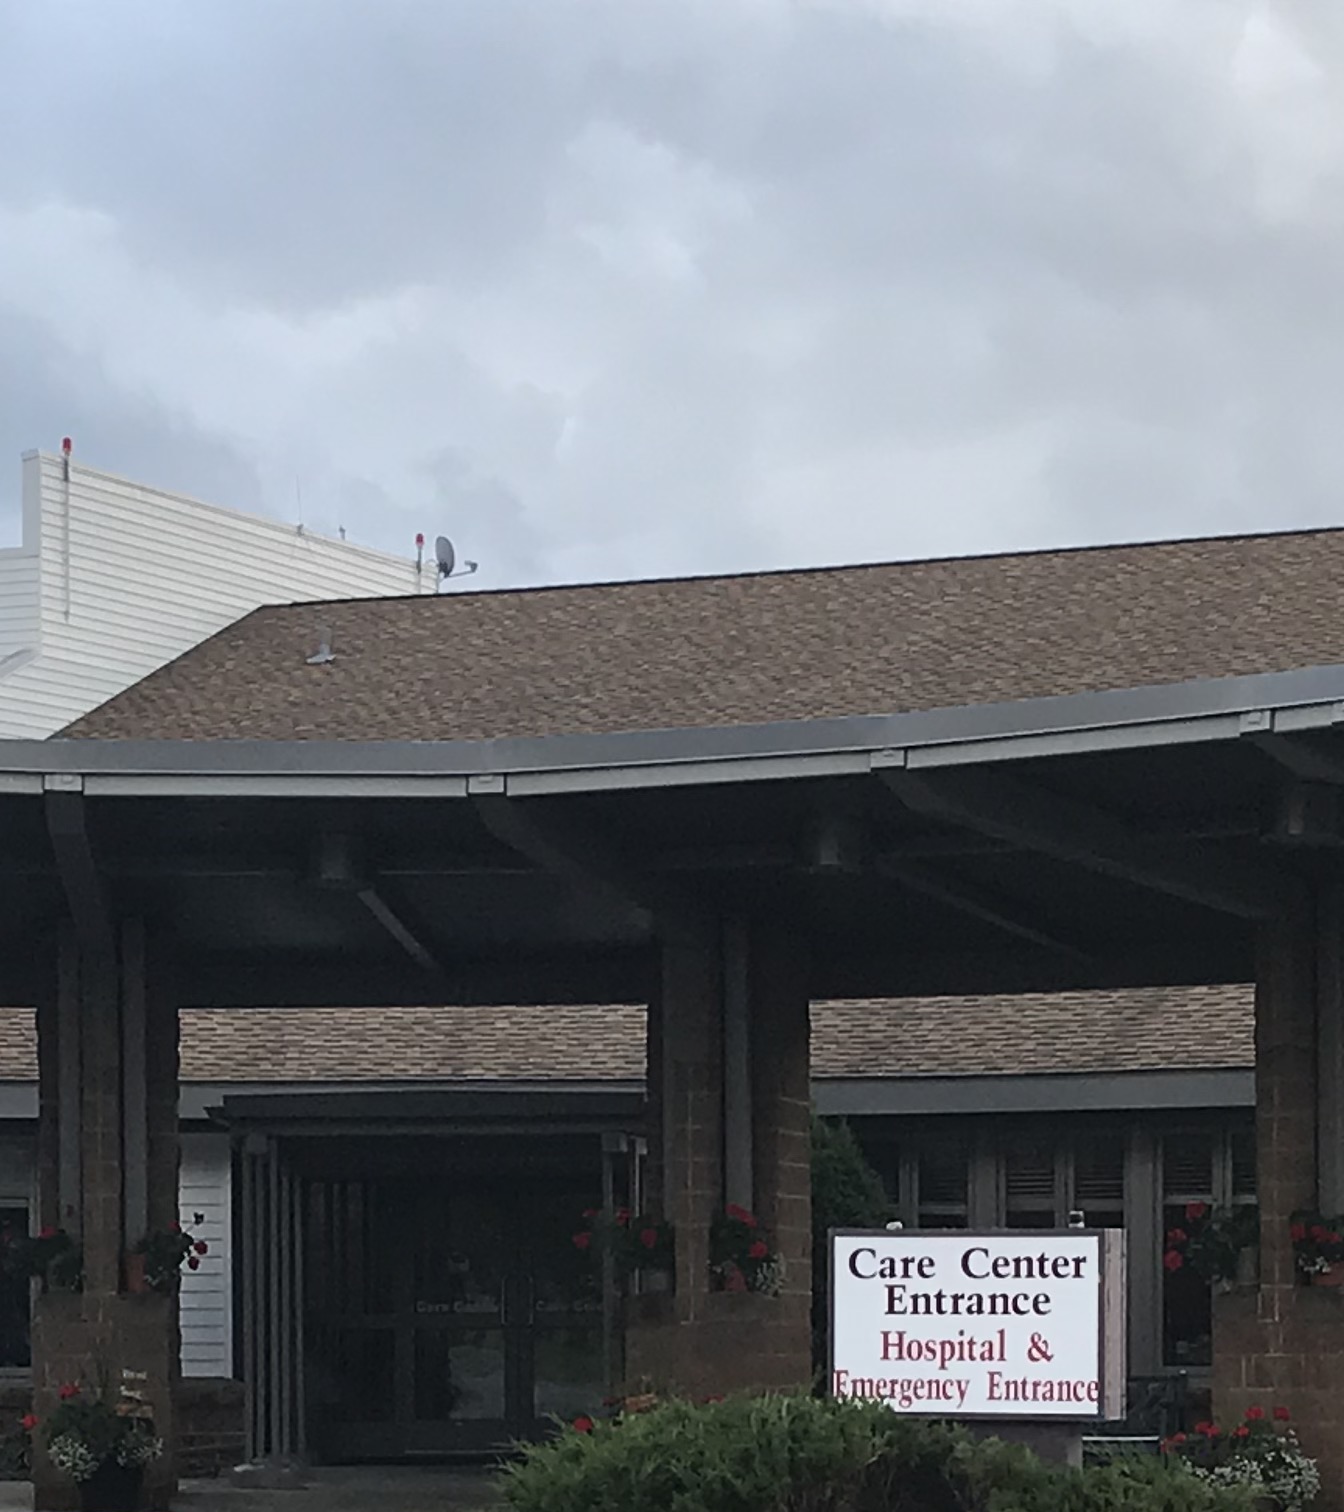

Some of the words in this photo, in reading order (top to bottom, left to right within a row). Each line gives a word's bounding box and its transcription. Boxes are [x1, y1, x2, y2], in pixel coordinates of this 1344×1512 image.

[848, 1247, 936, 1279] Care
[960, 1247, 1087, 1279] Center
[884, 1284, 1052, 1316] Entrance
[880, 1328, 1007, 1370] Hospital
[1026, 1331, 1054, 1363] &
[833, 1369, 970, 1408] Emergency
[987, 1371, 1100, 1402] Entrance
